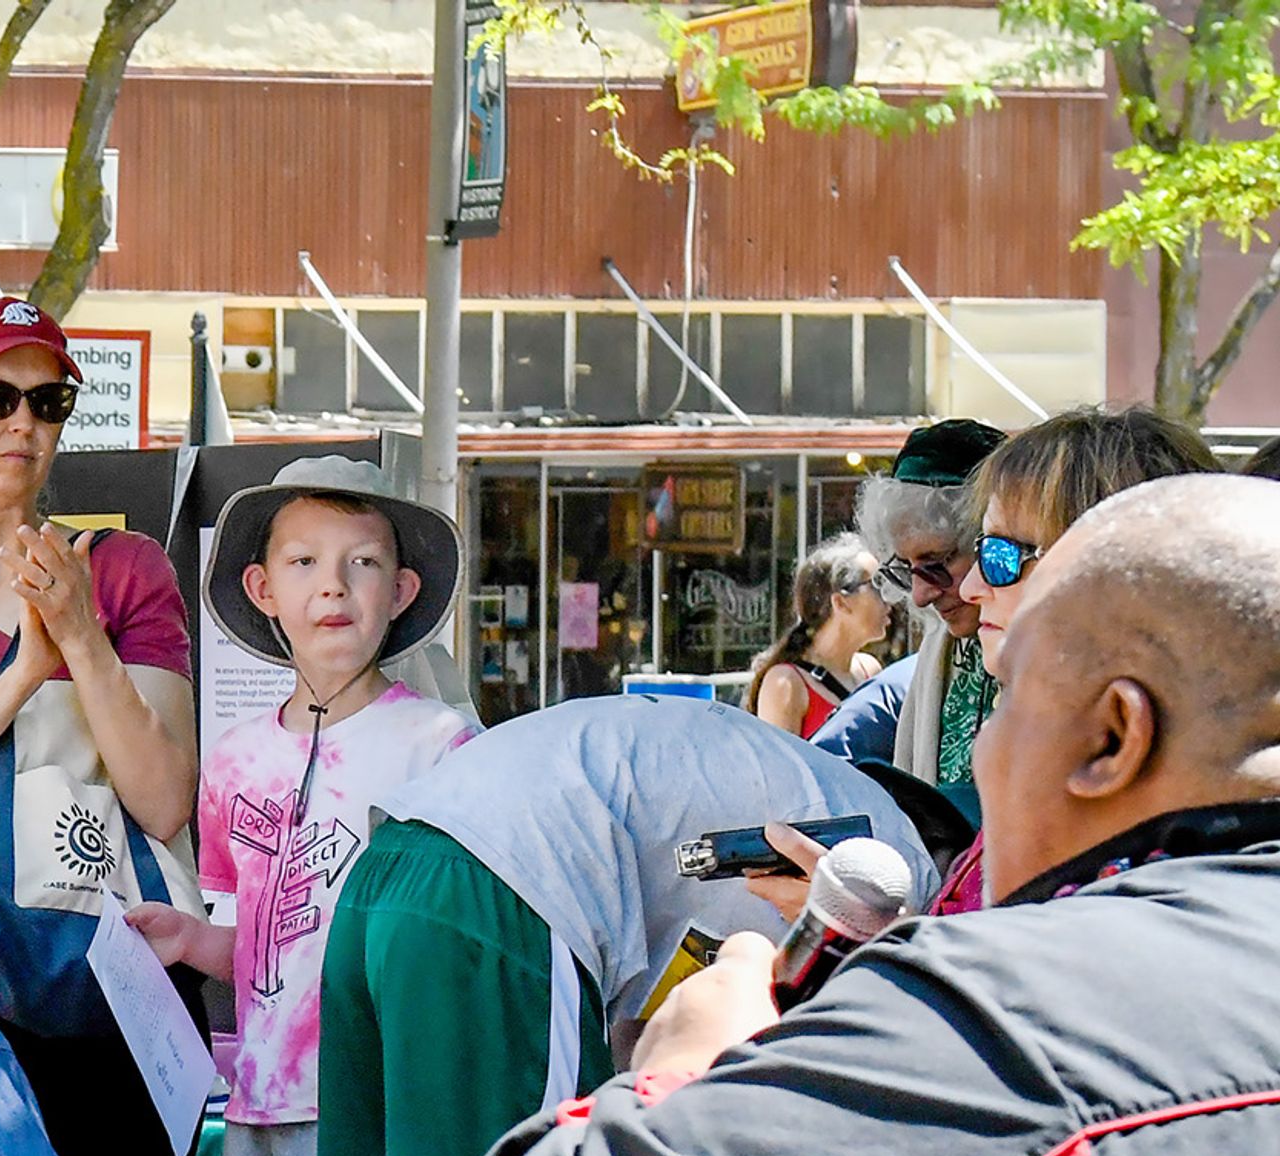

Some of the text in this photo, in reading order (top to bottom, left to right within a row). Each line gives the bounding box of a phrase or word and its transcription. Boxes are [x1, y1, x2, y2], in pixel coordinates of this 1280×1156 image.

[70, 346, 132, 370] mbing
[238, 808, 275, 839] LORD
[289, 839, 339, 880] DIRECT
[279, 913, 312, 936] PATH
